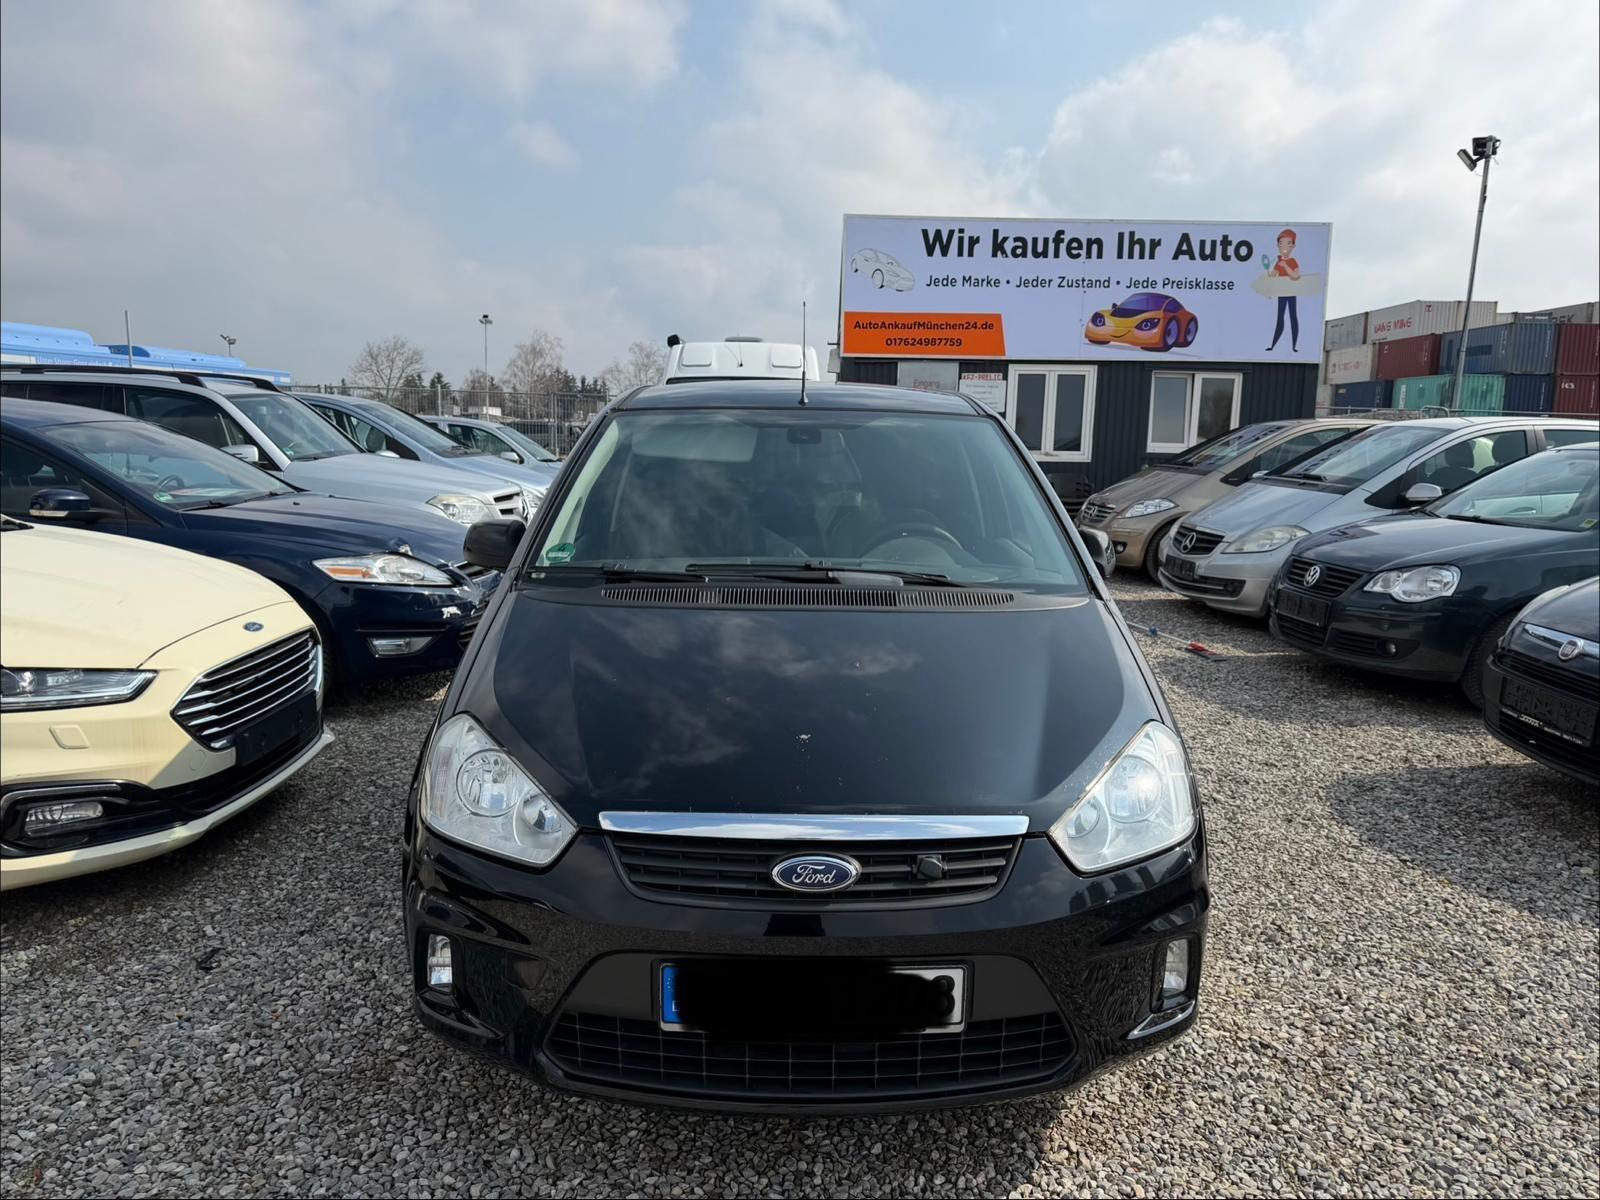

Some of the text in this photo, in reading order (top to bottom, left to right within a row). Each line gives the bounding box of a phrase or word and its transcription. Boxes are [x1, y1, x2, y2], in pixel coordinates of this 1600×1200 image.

[921, 228, 1254, 263] Wir kaufen Ihr Auto
[925, 275, 1235, 291] Jede Marke Jeder Zustand Jede Preisklasse
[853, 320, 995, 331] AutoAnkaufMünchen24.de
[885, 337, 963, 347] 017624987759
[792, 864, 835, 884] Ford
